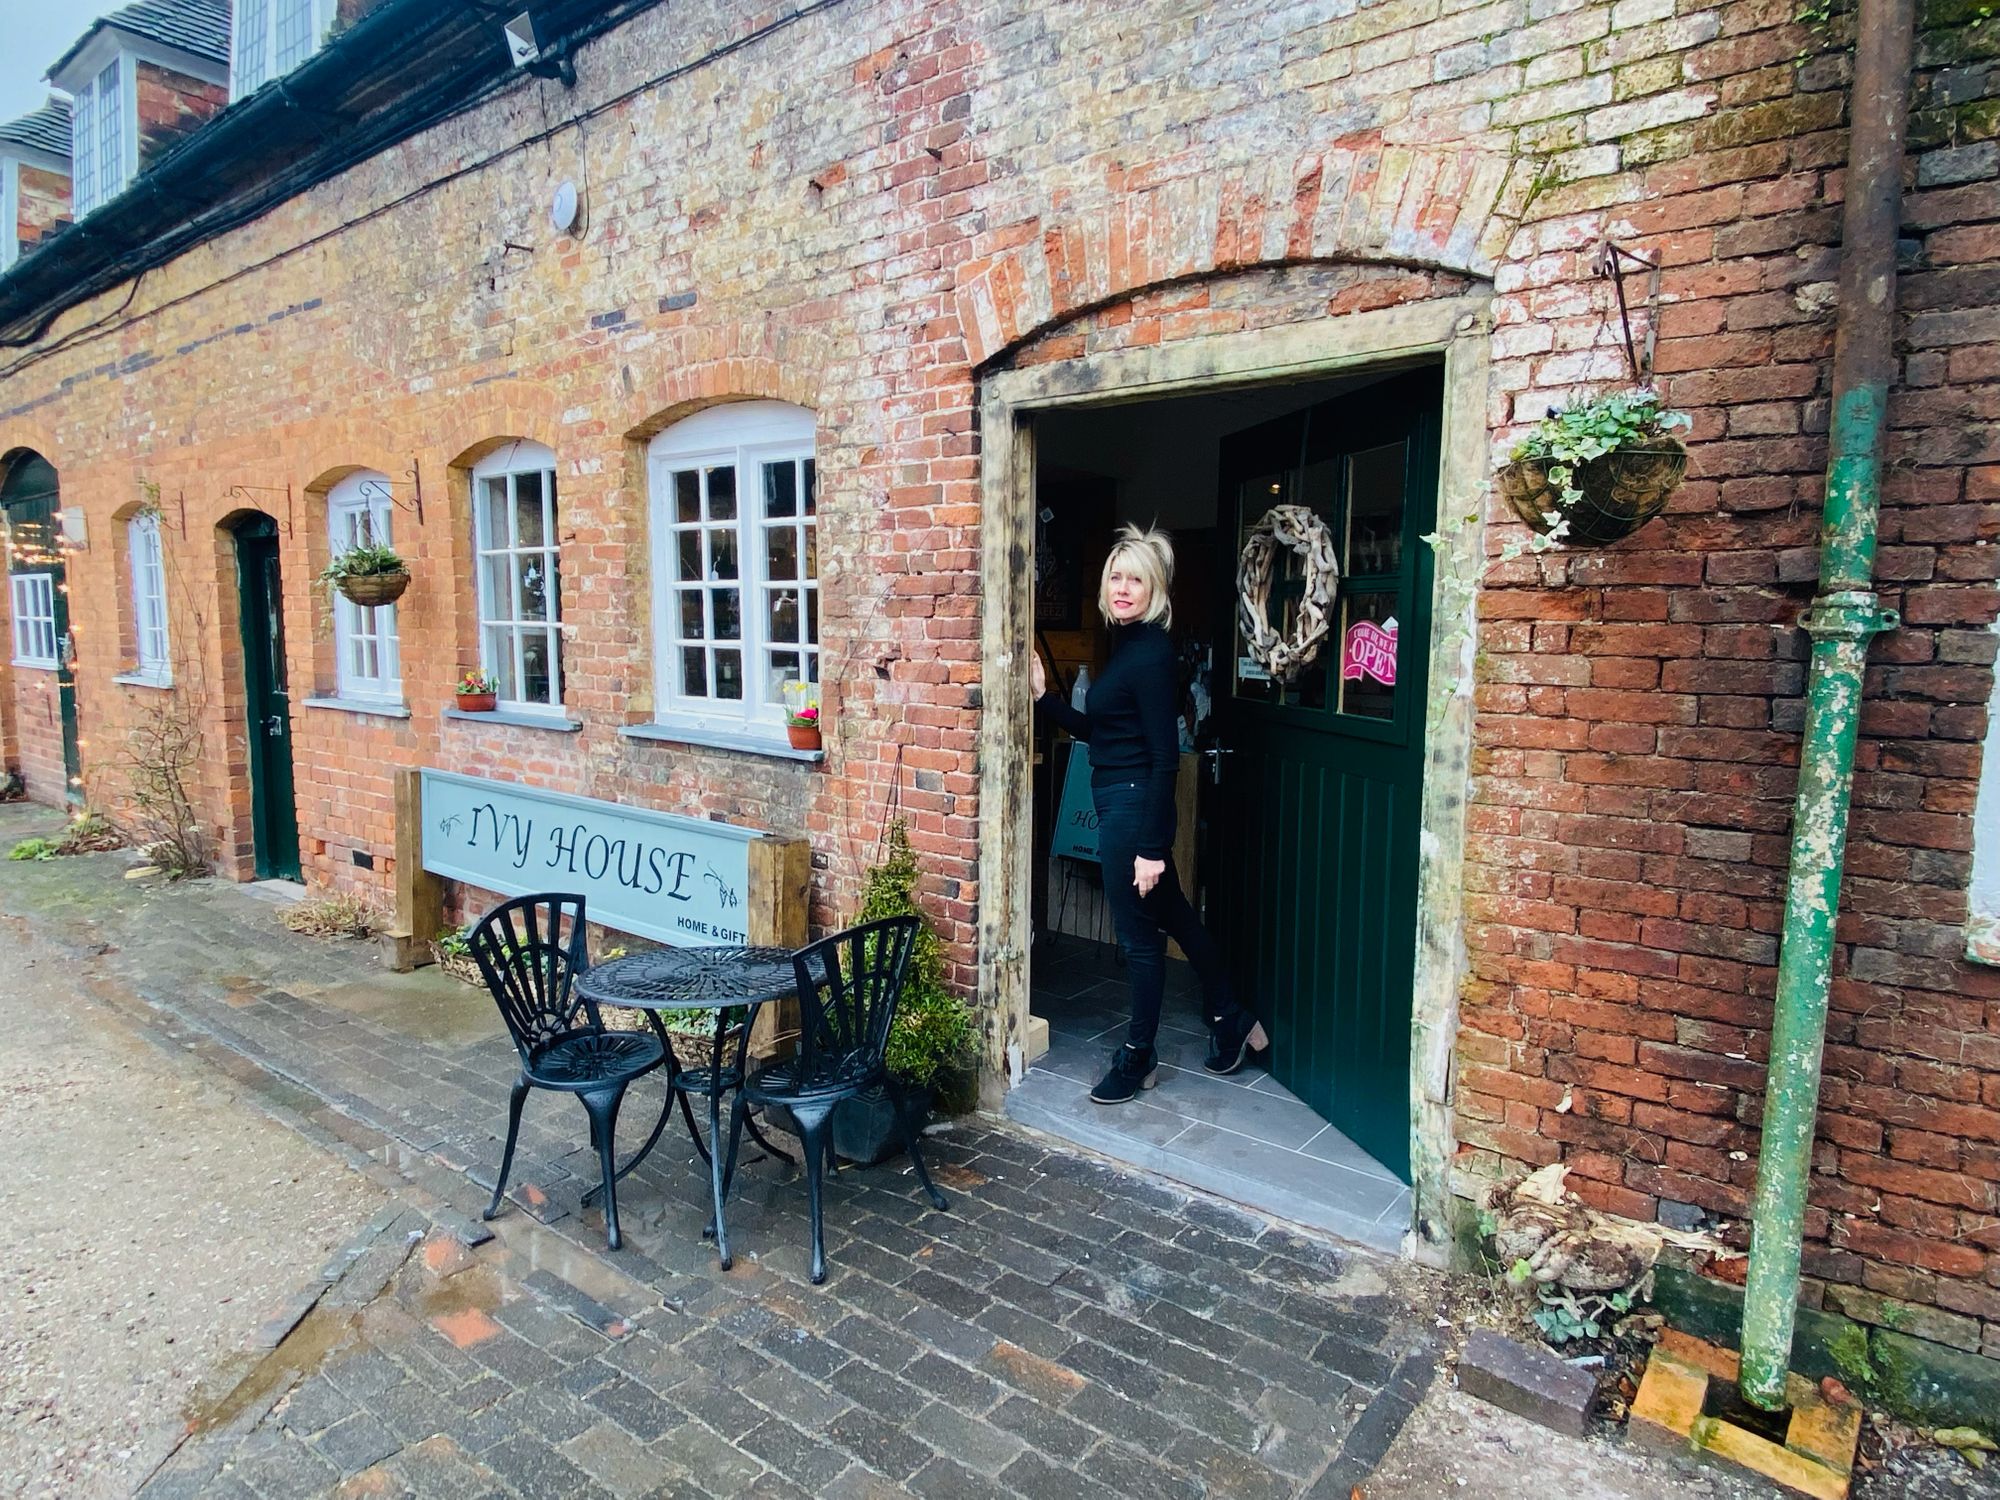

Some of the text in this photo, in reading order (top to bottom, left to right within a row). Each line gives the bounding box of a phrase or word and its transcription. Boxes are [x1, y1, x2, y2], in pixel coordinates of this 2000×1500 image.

[1352, 638, 1396, 677] OPEN
[467, 803, 696, 901] IVY HOUSE
[677, 915, 749, 945] HOME & GIFT
